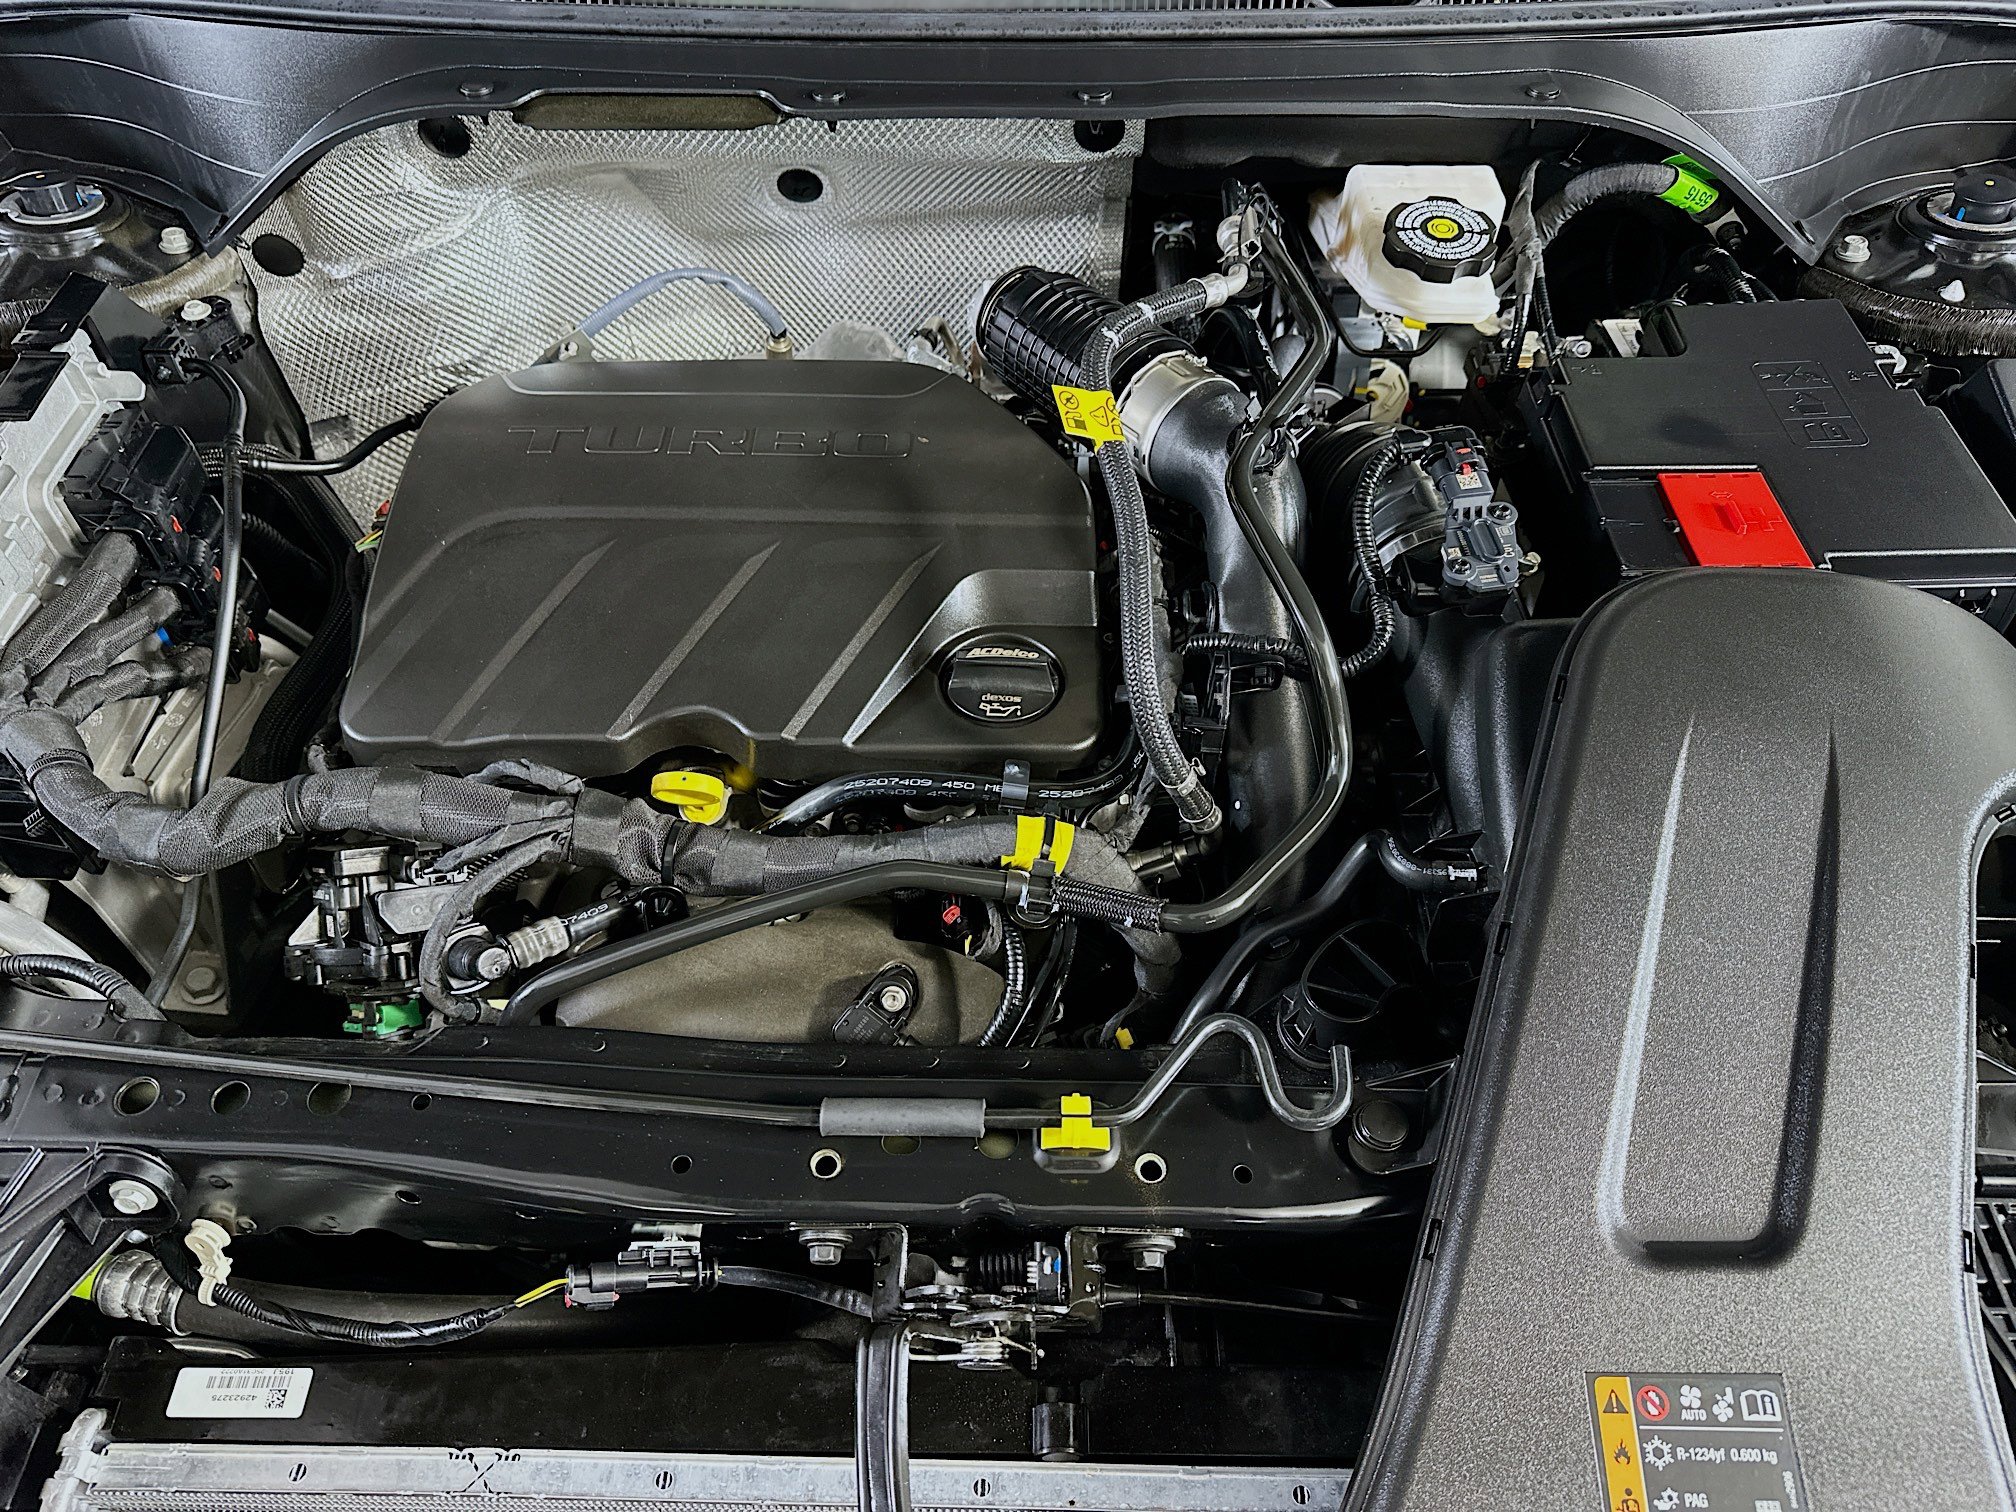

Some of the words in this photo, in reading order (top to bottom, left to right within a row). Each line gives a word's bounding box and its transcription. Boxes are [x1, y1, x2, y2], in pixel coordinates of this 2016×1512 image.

[1683, 186, 1713, 207] 5515
[508, 425, 911, 458] TURBO
[966, 647, 1040, 660] ACDelco
[981, 693, 1022, 703] dexos
[843, 777, 933, 791] 25207409
[942, 780, 976, 790] 450
[211, 1393, 258, 1402] 42923275
[1681, 1408, 1707, 1421] AUTO
[1676, 1446, 1726, 1464] R-1234yf
[1730, 1447, 1761, 1462] 0.600
[1762, 1448, 1778, 1465] kg
[1684, 1493, 1709, 1508] PAG
